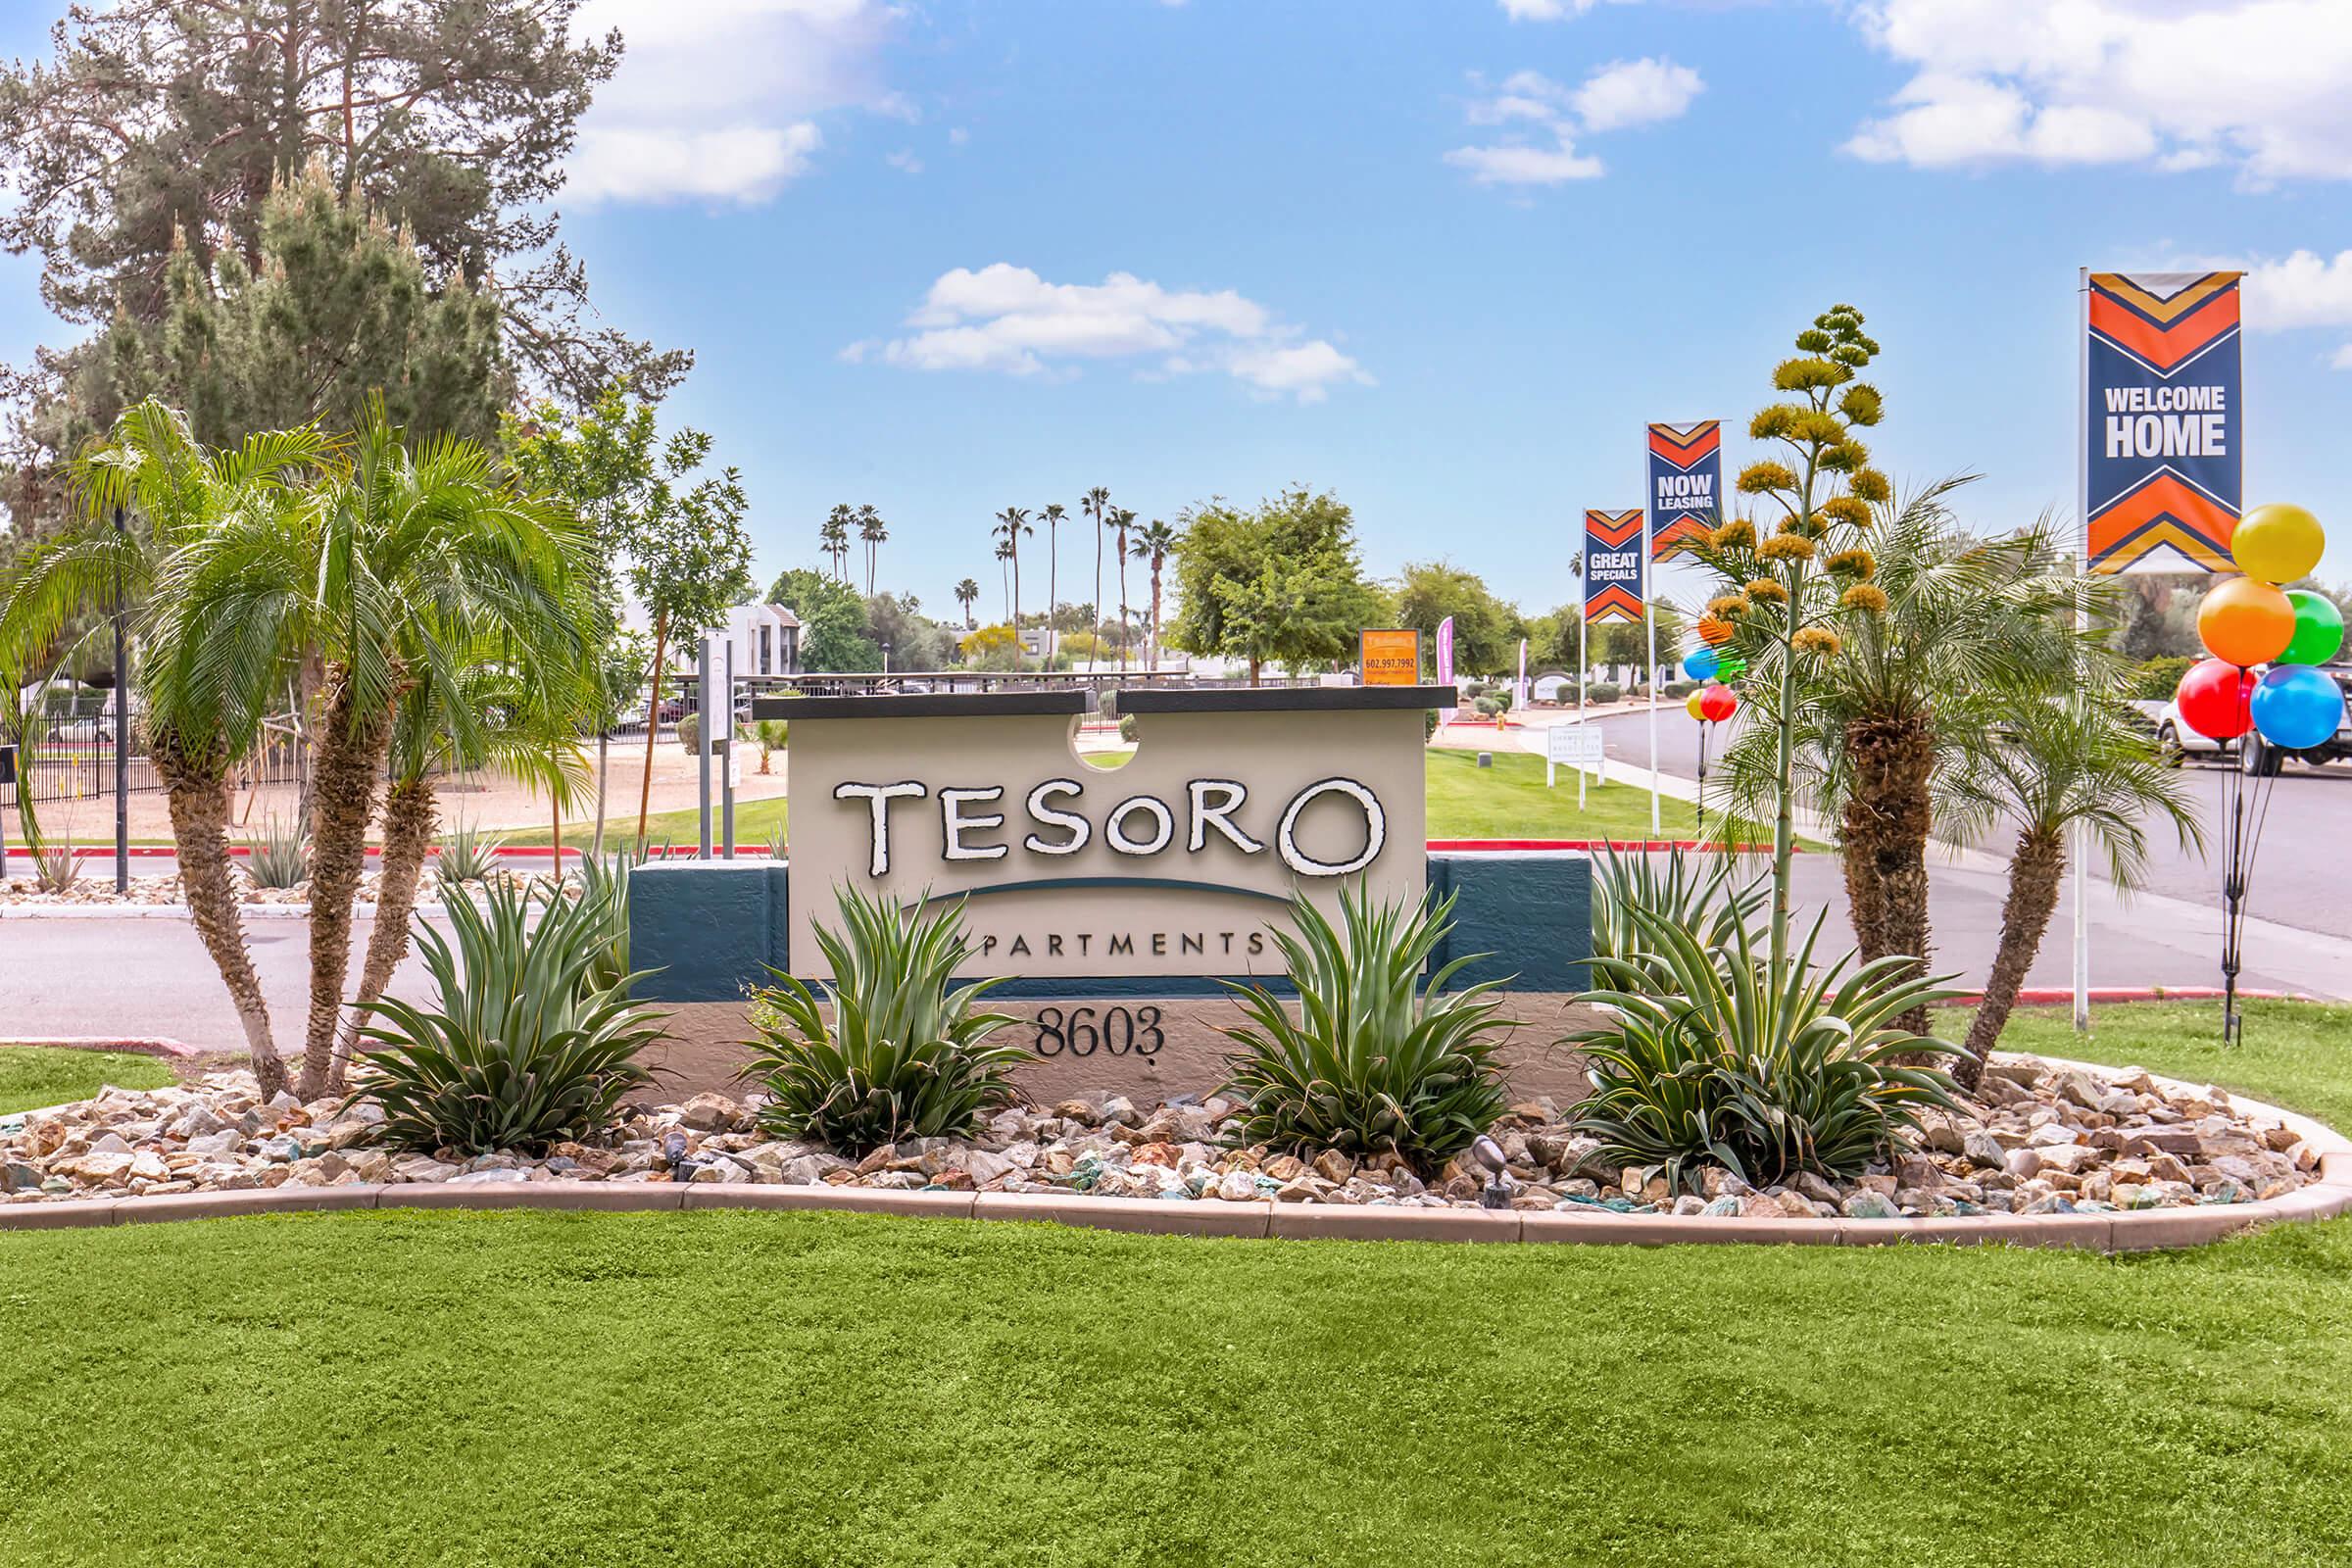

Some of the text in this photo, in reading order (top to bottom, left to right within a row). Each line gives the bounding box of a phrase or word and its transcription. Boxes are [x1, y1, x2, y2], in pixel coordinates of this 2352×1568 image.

[2105, 386, 2226, 413] WELCOME
[2106, 414, 2227, 458] HOME
[1657, 474, 1713, 497] NOW
[1657, 496, 1713, 511] LEASING
[1590, 552, 1639, 569] GREAT
[1590, 568, 1638, 581] SPECIALS
[1365, 658, 1415, 669] 602.997.7992
[833, 776, 1386, 878] TESORO
[1035, 1005, 1165, 1057] 8603
